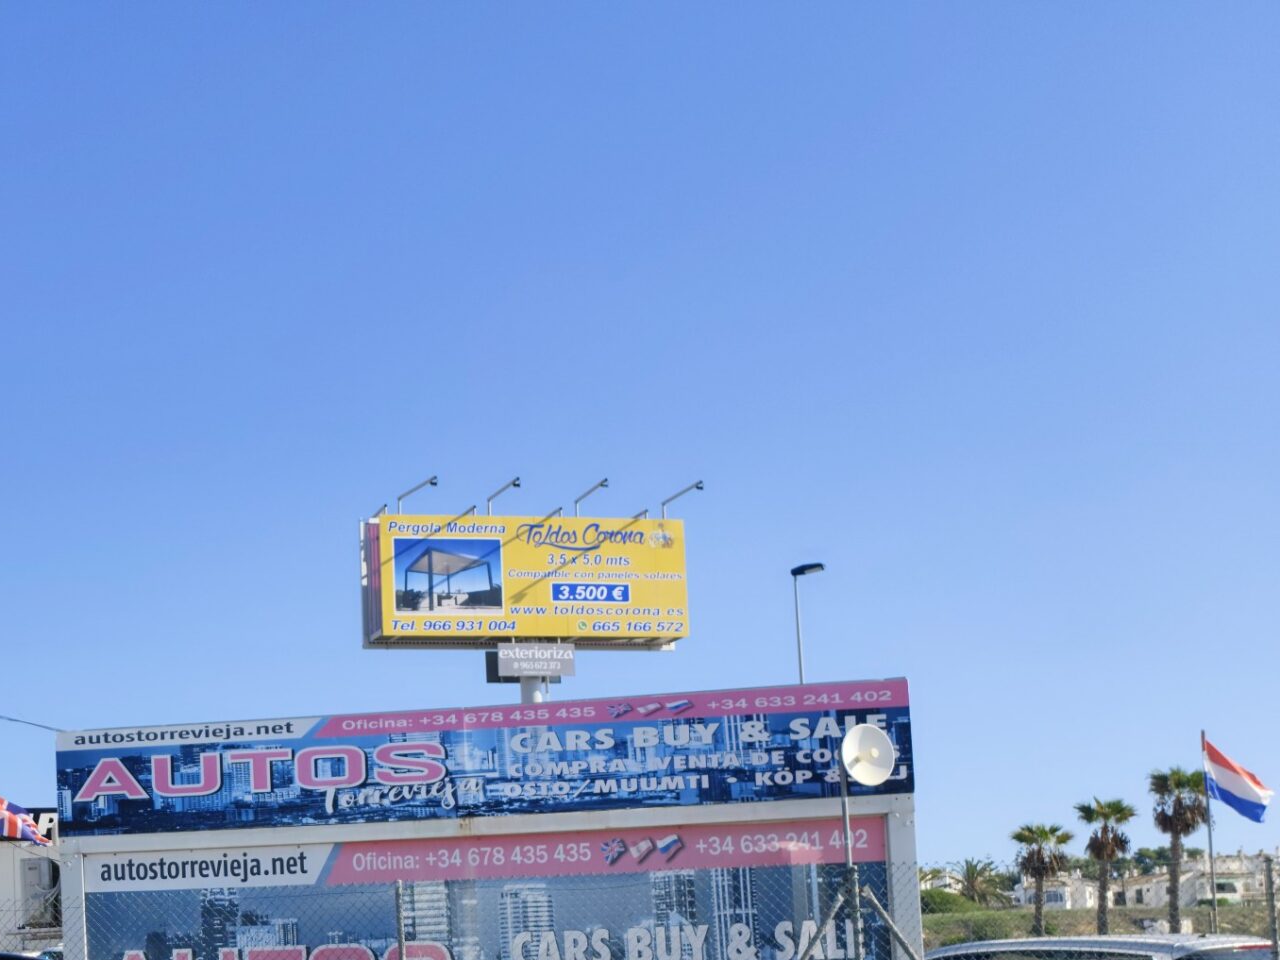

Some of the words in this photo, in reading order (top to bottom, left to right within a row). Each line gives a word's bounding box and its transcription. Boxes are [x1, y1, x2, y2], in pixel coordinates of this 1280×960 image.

[446, 522, 506, 534] Moderna
[516, 523, 578, 548] Toldos
[582, 523, 645, 546] Corona
[606, 555, 630, 566] mts
[508, 568, 571, 580] Compatible
[574, 571, 595, 579] con
[597, 570, 640, 580] paneles
[643, 570, 683, 580] solares
[558, 586, 608, 601] 3.500
[611, 587, 625, 601] €
[391, 620, 416, 631] Tel.
[423, 620, 452, 631] 966
[456, 620, 483, 631] 931
[488, 620, 517, 631] 004
[592, 621, 621, 632] 665
[627, 621, 652, 632] 166
[656, 622, 684, 632] 572
[499, 646, 574, 659] exterioriza
[706, 697, 748, 710] +34
[754, 695, 796, 708] 633
[803, 692, 844, 705] 241
[850, 690, 893, 703] 402
[342, 717, 413, 731] Oficina:
[419, 713, 458, 726] +34
[463, 711, 503, 724] 678
[509, 709, 549, 721] 435
[555, 706, 596, 719] 435
[74, 721, 295, 746] autostorrevieja.net
[510, 728, 615, 753] CARS
[632, 723, 720, 748] BUY
[740, 720, 770, 743] &
[73, 742, 450, 803] AUTOS
[508, 758, 628, 778] COMPRA
[650, 751, 741, 770] VENTA
[750, 751, 785, 766] DE
[504, 774, 710, 798] OSTO/MUUMTI
[755, 767, 813, 786] KÖP
[324, 776, 487, 815] Torrevieja
[695, 835, 734, 855] +34
[740, 833, 780, 853] 633
[785, 831, 824, 851] 241
[100, 851, 309, 882] autostorrevieja.net
[352, 852, 420, 871] Oficina:
[425, 849, 462, 868] +34
[468, 846, 505, 866] 678
[510, 844, 548, 865] 435
[553, 842, 592, 862] 435
